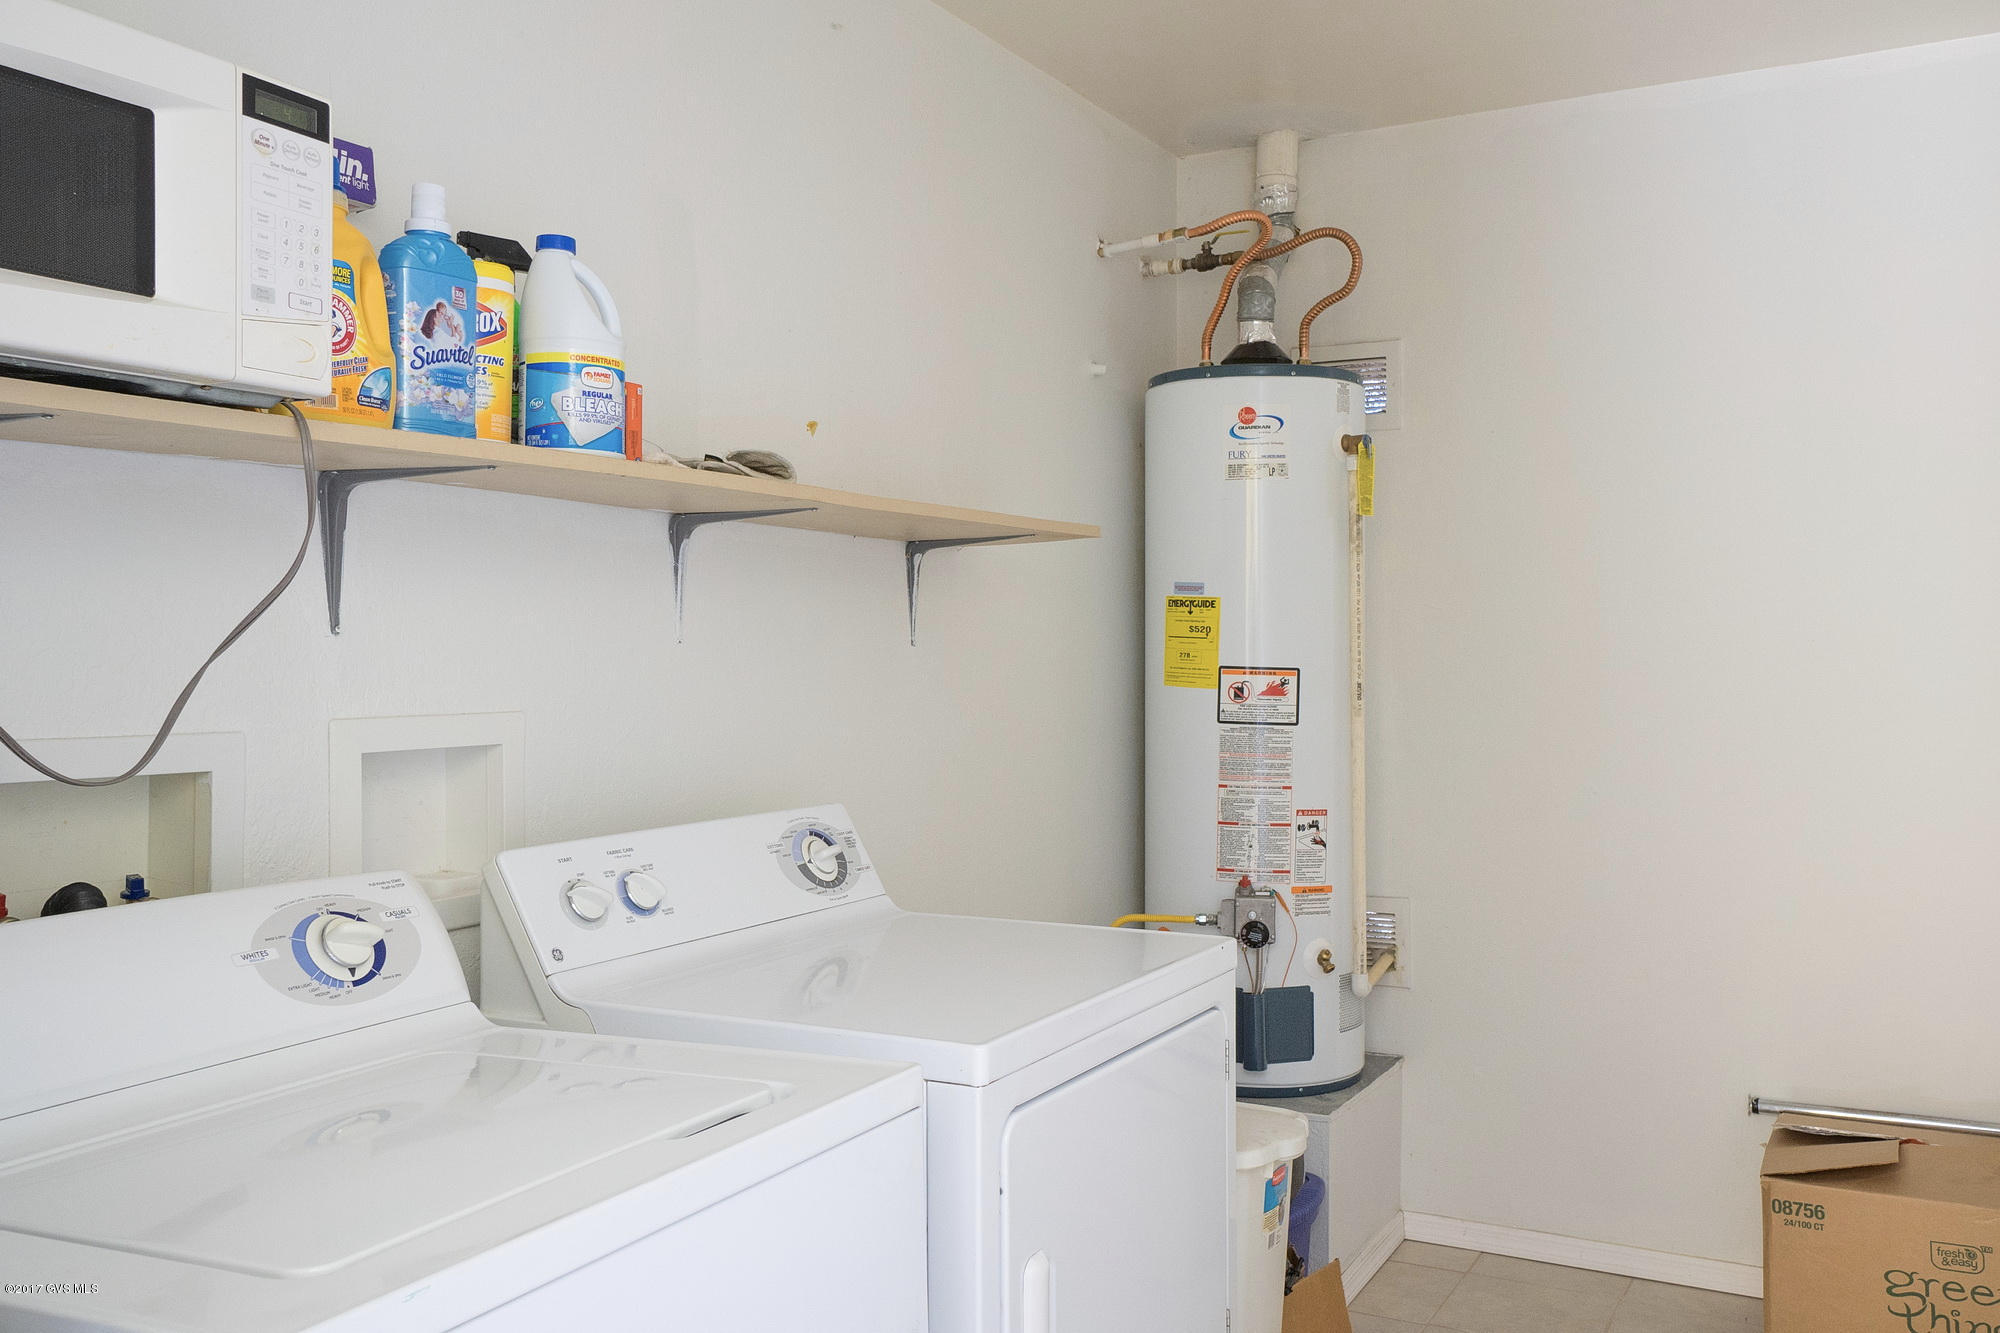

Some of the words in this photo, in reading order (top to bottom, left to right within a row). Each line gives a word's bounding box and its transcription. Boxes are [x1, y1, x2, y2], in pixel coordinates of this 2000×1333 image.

[352, 177, 370, 191] light
[299, 224, 305, 233] 2
[313, 229, 320, 237] 3
[299, 242, 305, 251] 5
[314, 246, 320, 255] 6
[283, 256, 289, 265] 7
[299, 260, 304, 269] 8
[313, 264, 319, 272] 9
[298, 278, 304, 287] 0
[410, 345, 475, 370] Suavitel
[569, 353, 621, 368] CONCENTRATED
[582, 390, 613, 400] REGULAR
[561, 395, 625, 417] BLEACH
[1268, 467, 1276, 476] LP
[1167, 599, 1217, 609] ENERGYGUIDE
[1188, 625, 1212, 634] $520
[557, 856, 573, 864] START
[385, 908, 412, 918] CASUALS
[240, 949, 269, 961] WHITES
[1771, 1198, 1826, 1221] 08756
[1783, 1218, 1812, 1230] 24/100
[1813, 1222, 1825, 1231] CT
[1936, 1246, 1965, 1259] fresh
[1883, 1269, 2000, 1307] gree
